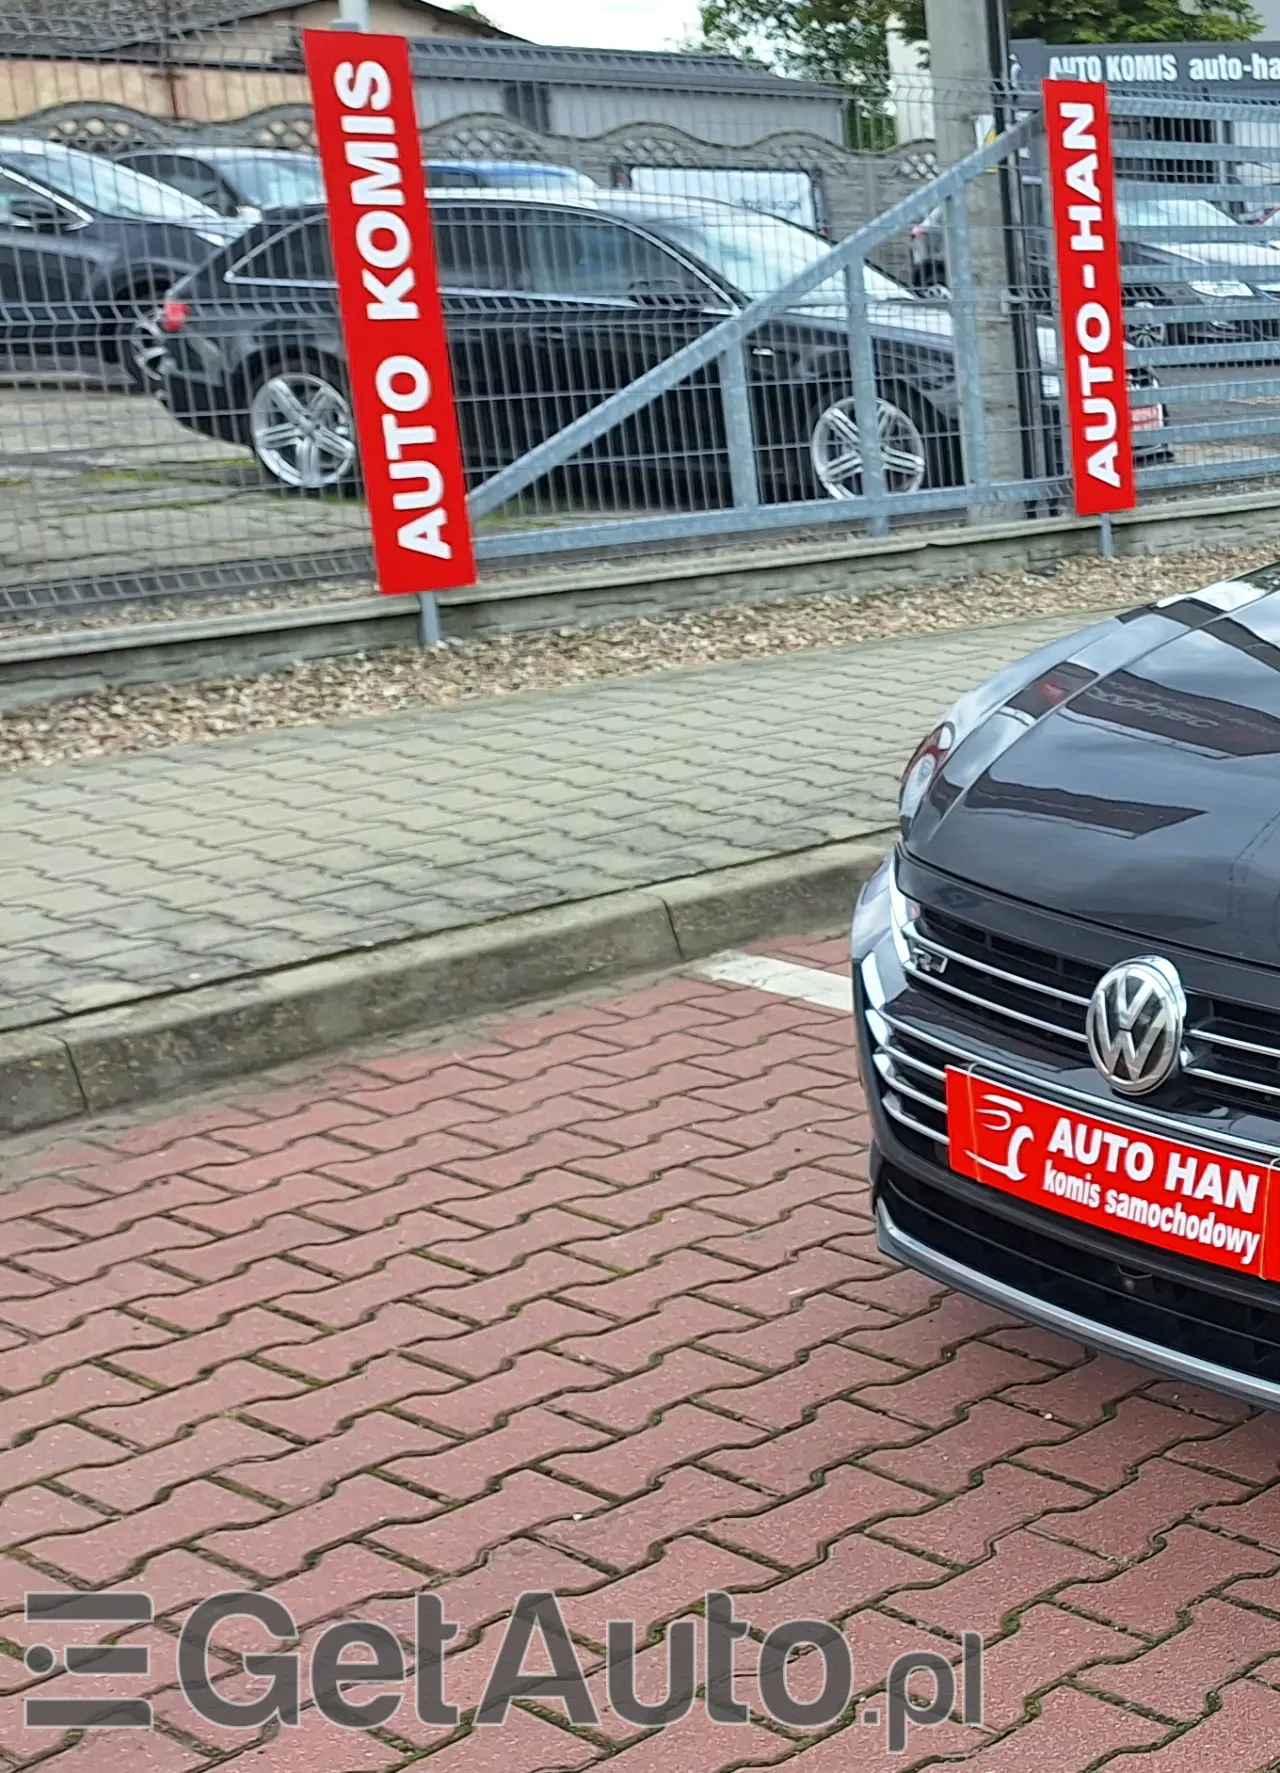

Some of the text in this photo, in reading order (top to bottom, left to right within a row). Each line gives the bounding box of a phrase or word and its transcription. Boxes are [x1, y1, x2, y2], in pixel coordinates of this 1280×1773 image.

[1050, 55, 1100, 82] AUTO
[1106, 54, 1177, 82] KOMIS
[334, 61, 452, 559] AUTO KOMIS
[1043, 1159, 1261, 1265] komis samochodowy
[1047, 1117, 1260, 1214] AUTO HAN
